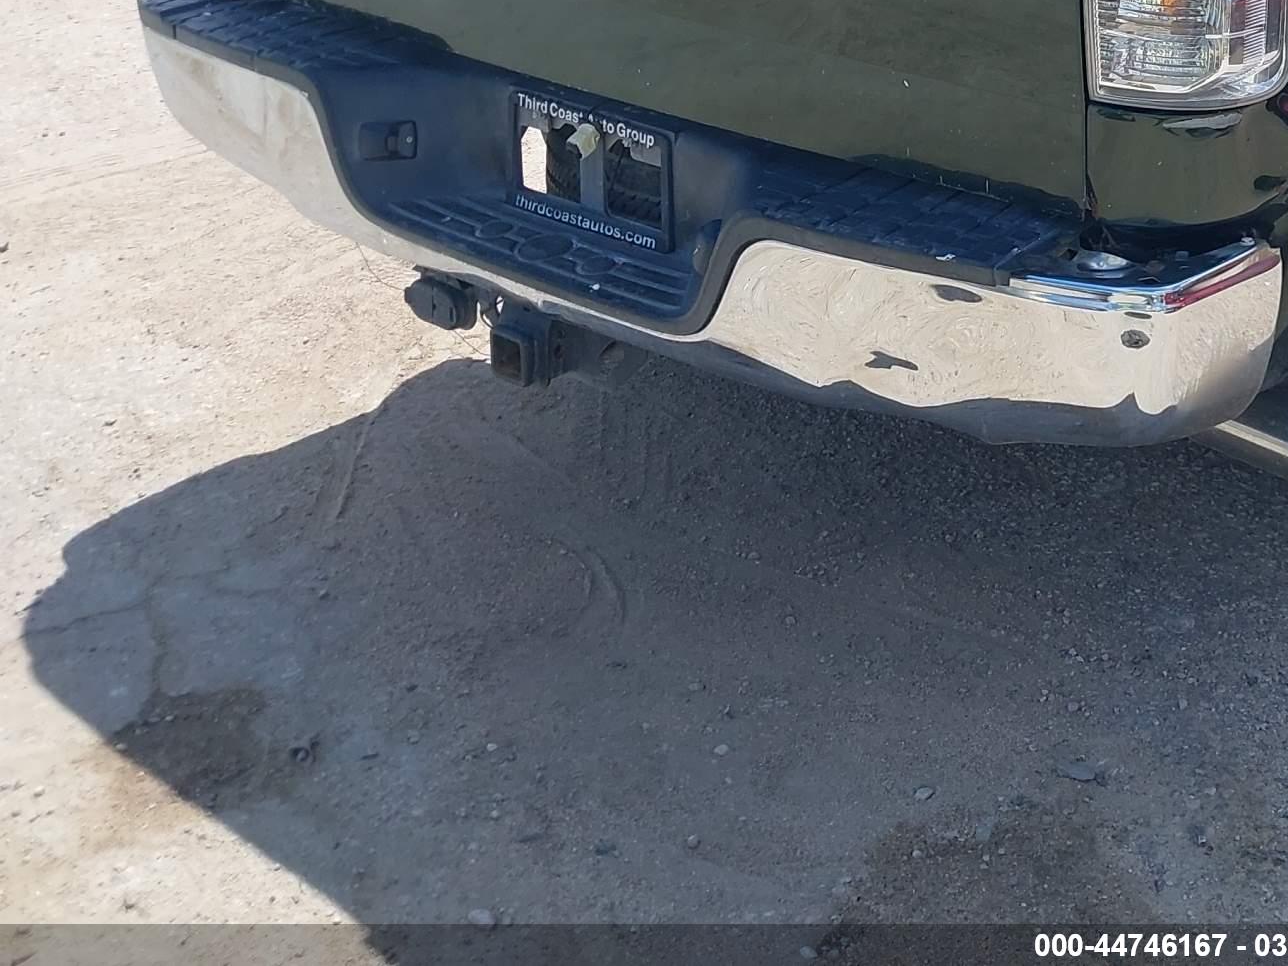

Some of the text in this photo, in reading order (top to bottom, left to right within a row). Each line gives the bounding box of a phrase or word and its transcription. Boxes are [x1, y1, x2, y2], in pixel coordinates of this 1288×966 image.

[518, 93, 548, 114] Third
[616, 123, 655, 149] Group
[516, 194, 657, 249] thirdcoastautos.com
